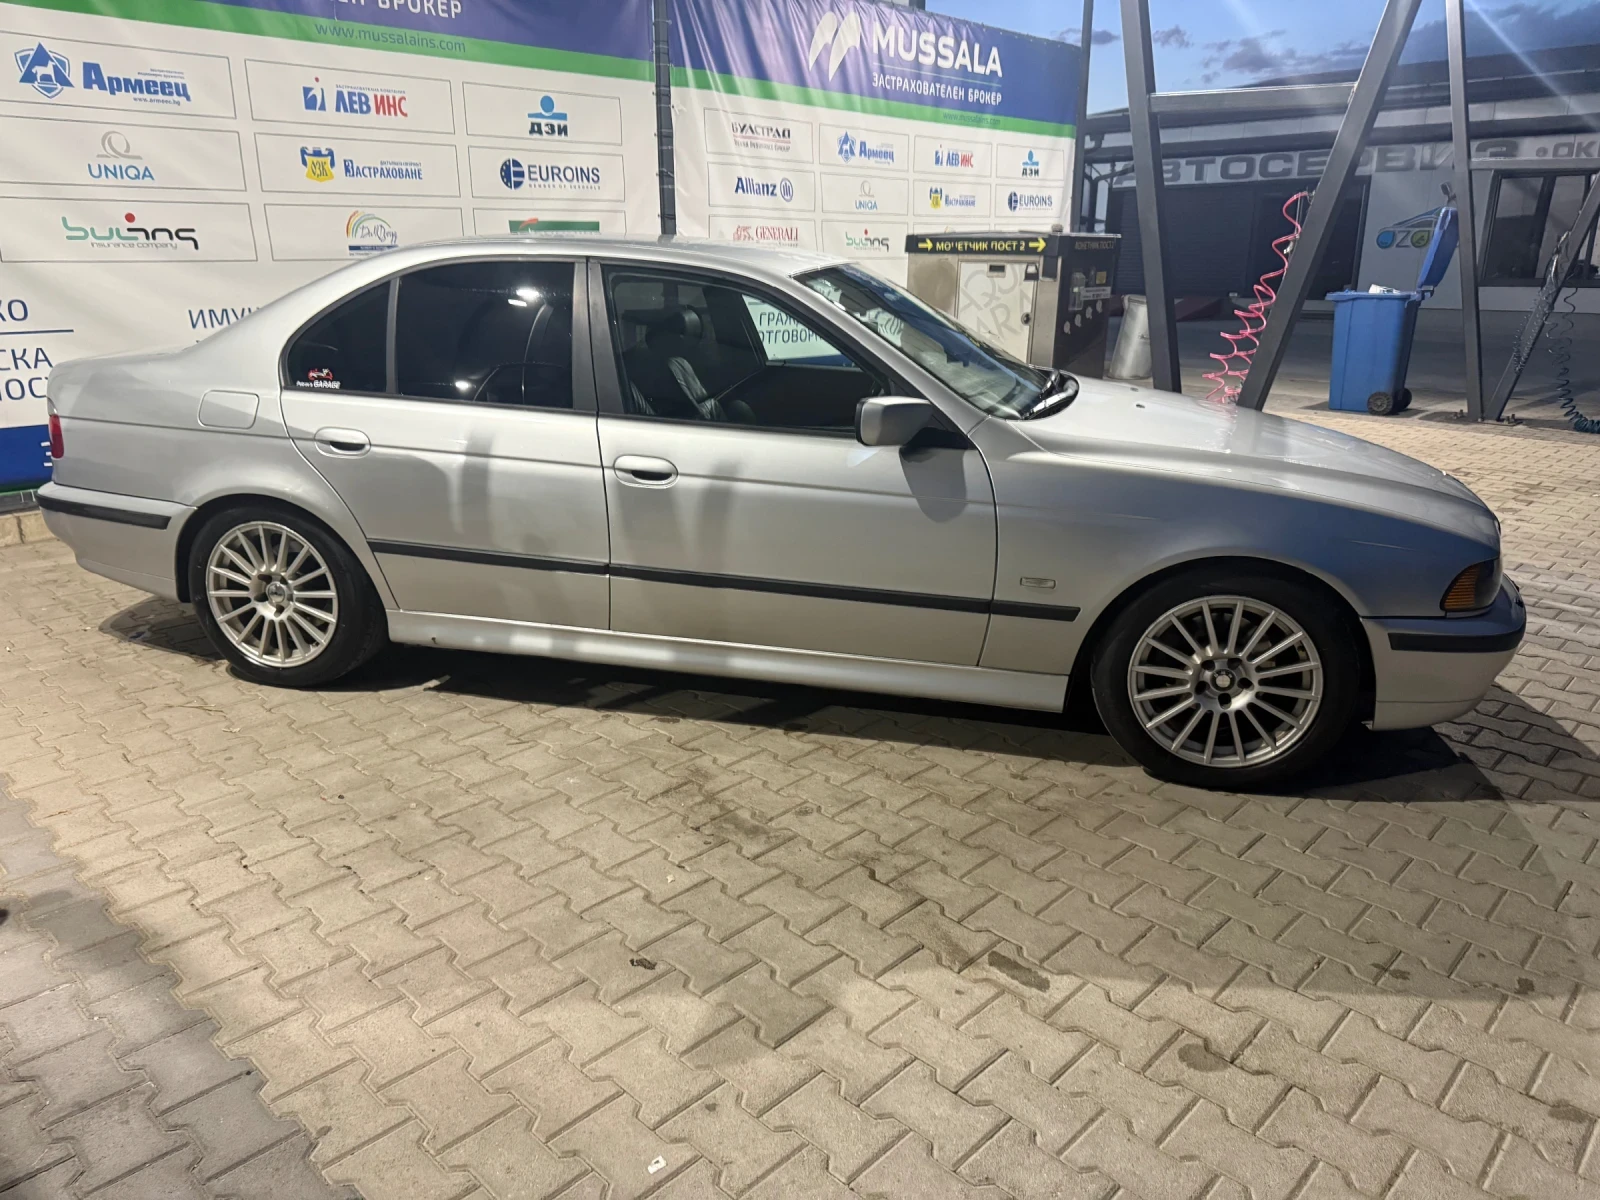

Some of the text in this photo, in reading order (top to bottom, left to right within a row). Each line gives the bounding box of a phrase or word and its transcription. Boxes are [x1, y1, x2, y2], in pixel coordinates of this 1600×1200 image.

[314, 23, 466, 53] www.mussalains.com
[872, 21, 1002, 78] MUSSALA
[83, 61, 192, 102] Армеец
[872, 72, 1002, 106] ЗАСТРАХОВАТЕЛЕН БРОКЕР
[335, 89, 408, 118] ЛЕВ ИНС
[528, 121, 569, 137] ДЗИ
[1552, 141, 1600, 158] ОК
[946, 151, 974, 168] ЛЕВ ИНС
[87, 162, 156, 181] UNIQA
[343, 159, 424, 181] ЗАСТРАХОВАНЕ
[527, 164, 601, 185] EUROINS
[1021, 167, 1040, 177] ДЗИ
[734, 176, 778, 197] Allianz
[855, 199, 878, 211] UNIQA
[1019, 194, 1053, 208] EUROINS
[755, 224, 799, 242] GENERALI
[91, 241, 178, 251] insurance company
[1019, 240, 1026, 250] 2
[188, 307, 260, 329] ИМУ
[760, 312, 801, 328] ГРАЖ
[759, 328, 823, 345] ТГОВОР
[0, 376, 49, 401] ОС
[314, 380, 340, 389] GARAGE
